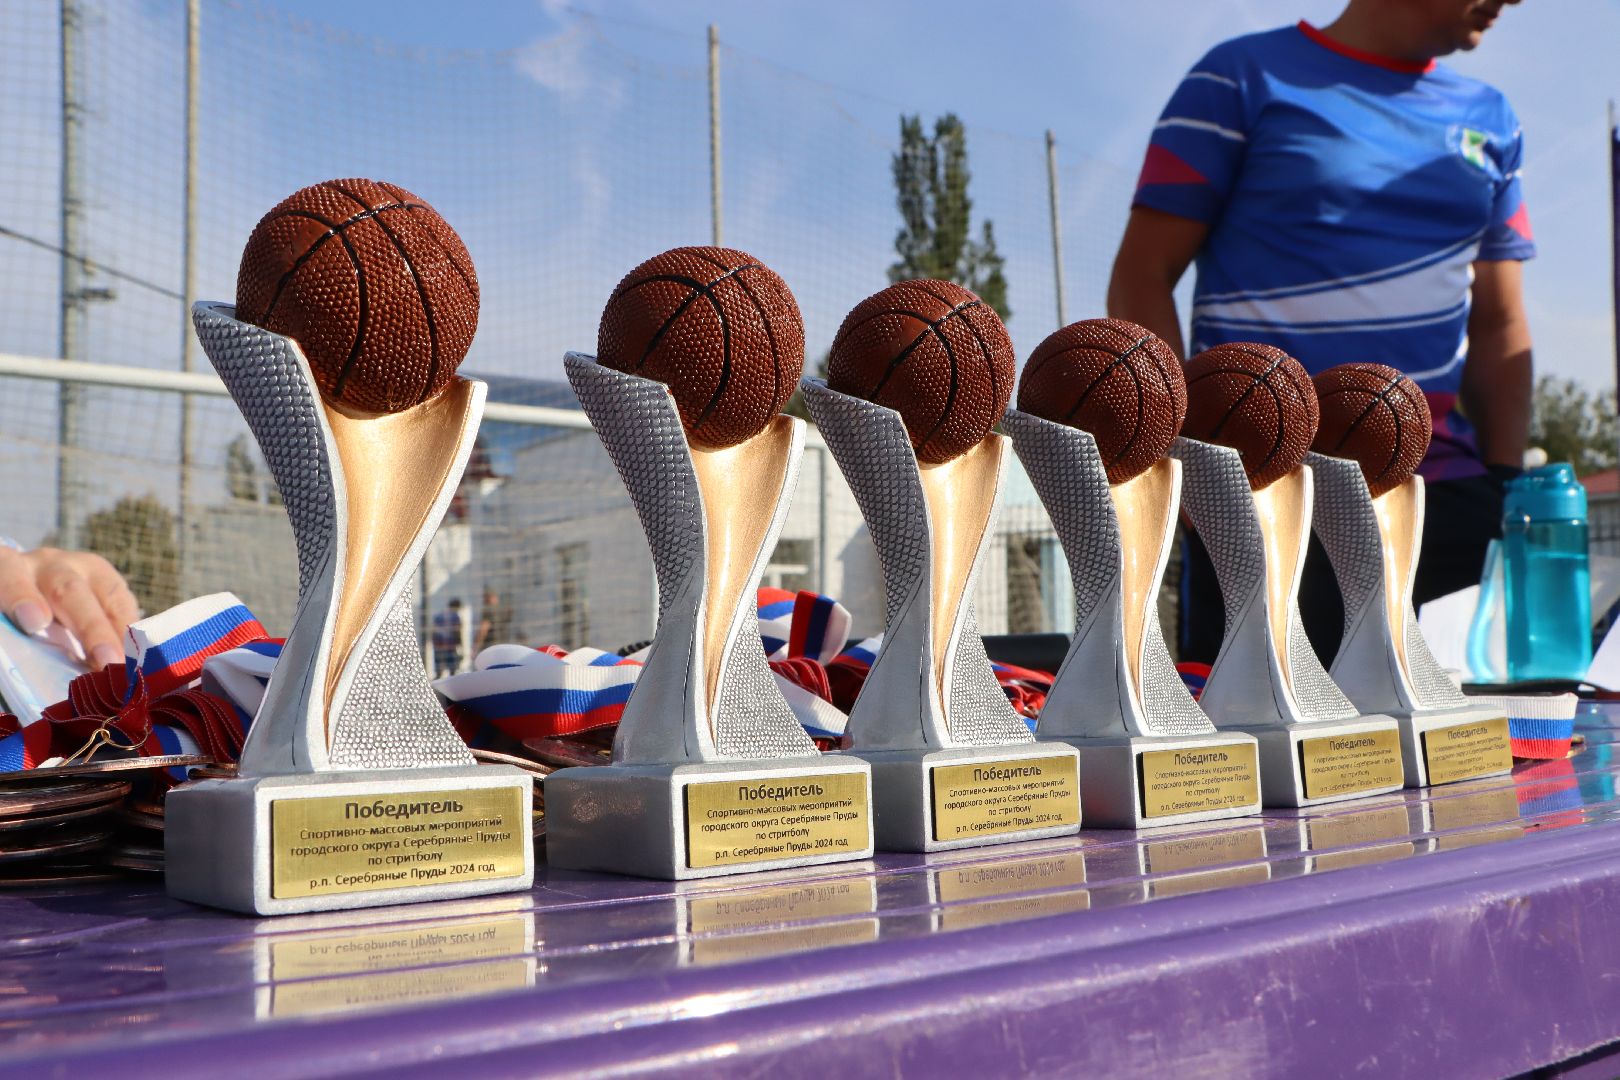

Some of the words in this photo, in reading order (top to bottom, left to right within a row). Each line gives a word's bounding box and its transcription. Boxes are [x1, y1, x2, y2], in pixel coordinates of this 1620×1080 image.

[1448, 727, 1488, 740] Победитель
[1330, 738, 1375, 751] Победитель
[1175, 752, 1228, 765] Победитель
[974, 767, 1041, 781] Победитель
[739, 784, 823, 801] Победитель
[950, 785, 1020, 797] Спортивно-массовых
[1023, 778, 1064, 791] мероприятий
[345, 800, 463, 819] Победитель
[707, 804, 796, 819] Спортивно-массовых
[799, 798, 852, 811] мероприятий
[945, 800, 982, 810] городского
[1008, 792, 1048, 804] Серебряные
[300, 824, 425, 841] Спортивно-массовых
[429, 815, 502, 833] мероприятий
[701, 821, 748, 832] городского
[752, 819, 778, 829] округа
[781, 813, 831, 827] Серебряные
[833, 811, 858, 822] Пруды
[970, 820, 1011, 832] Серебряные
[1013, 818, 1033, 827] Пруды
[1036, 814, 1050, 822] 2024
[756, 832, 766, 840] по
[769, 828, 810, 840] стритболу
[291, 842, 358, 857] городского
[362, 840, 400, 853] округа
[404, 833, 472, 849] Серебряные
[476, 831, 510, 845] Пруды
[716, 850, 730, 860] р.п.
[733, 845, 784, 857] Серебряные
[787, 842, 812, 852] Пруды
[815, 839, 833, 848] 2024
[835, 838, 848, 846] год
[368, 856, 382, 866] по
[386, 852, 443, 866] стритболу
[310, 876, 331, 889] р.п.
[336, 870, 407, 885] Серебряные
[411, 866, 446, 878] Пруды
[450, 864, 474, 875] 2024
[478, 863, 495, 873] год
